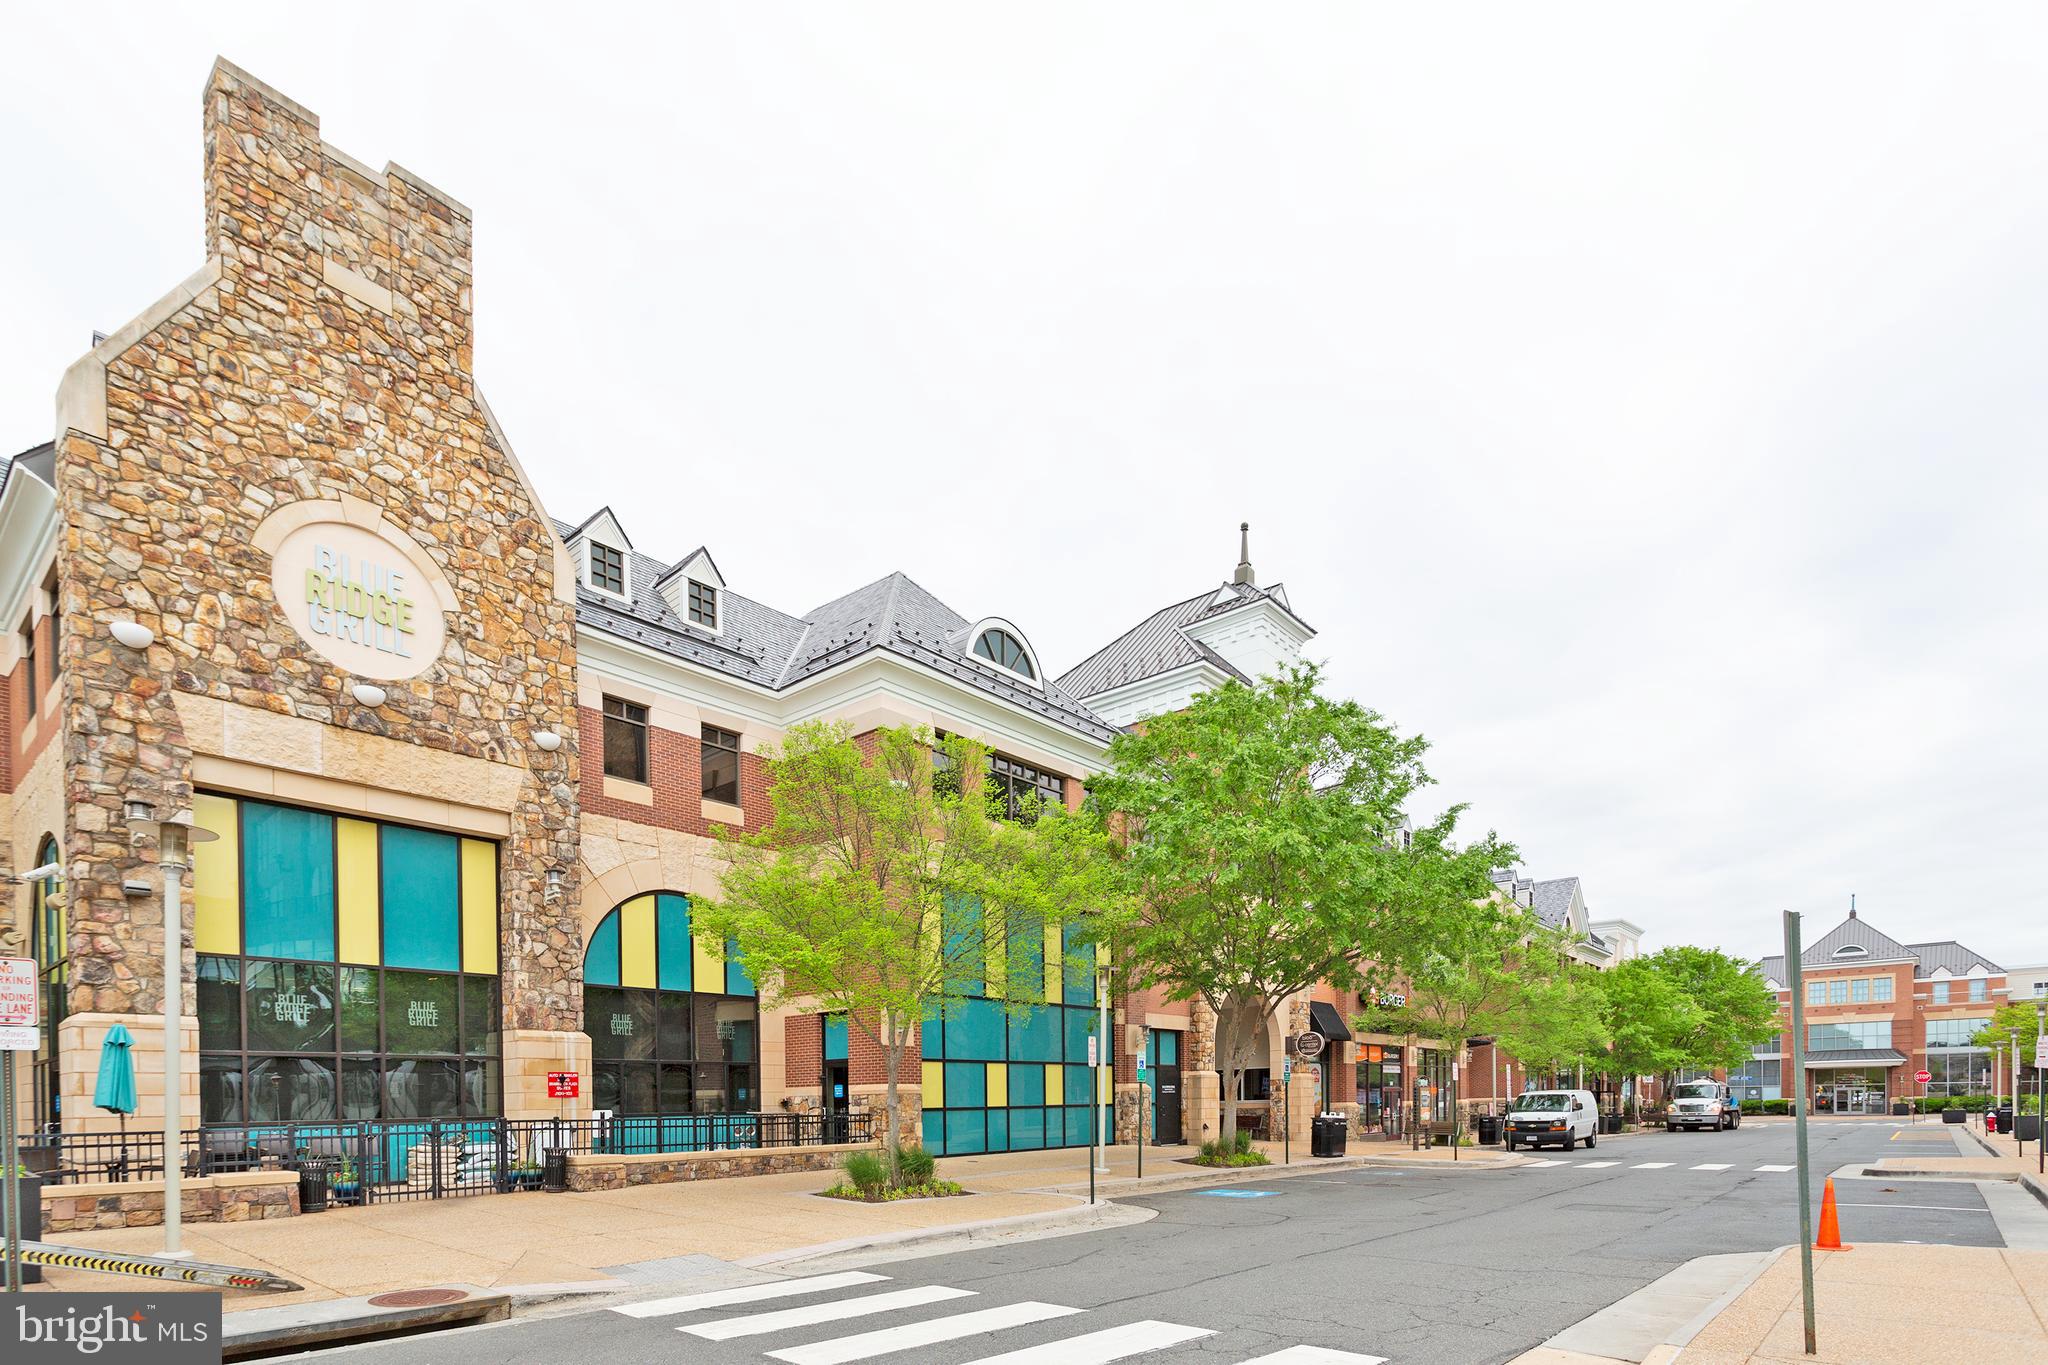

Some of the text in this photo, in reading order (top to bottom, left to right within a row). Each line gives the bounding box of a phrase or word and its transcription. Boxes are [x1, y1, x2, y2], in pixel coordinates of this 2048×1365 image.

[315, 543, 405, 605] BLUE
[305, 567, 416, 636] RIDGE
[308, 600, 413, 659] GRILL
[7, 1003, 33, 1015] LANE
[409, 1017, 438, 1027] GRILL
[411, 1001, 436, 1010] BLUE
